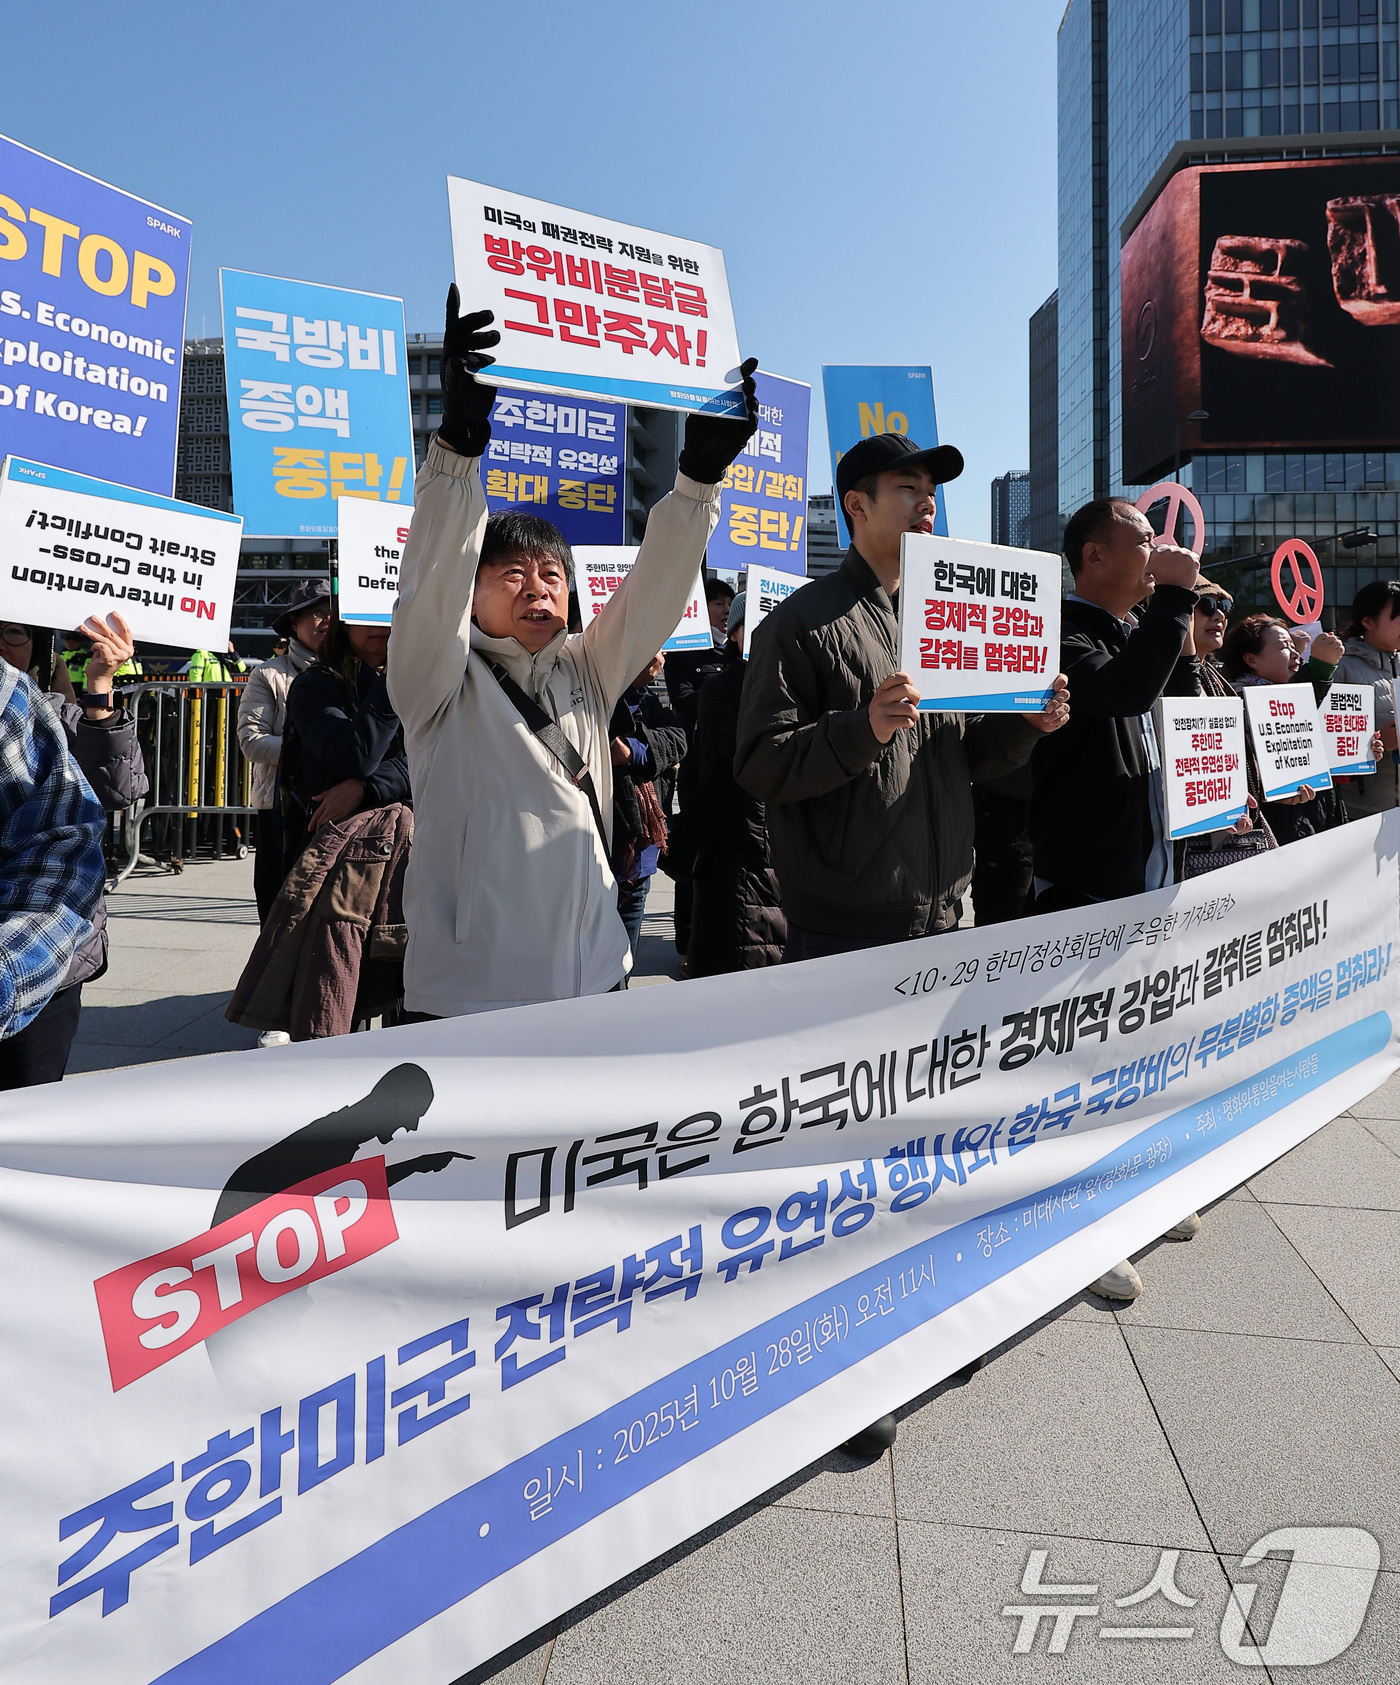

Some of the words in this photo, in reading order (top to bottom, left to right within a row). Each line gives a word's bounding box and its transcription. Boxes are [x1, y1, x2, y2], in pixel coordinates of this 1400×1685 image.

[146, 215, 181, 238] SPARK
[484, 205, 536, 233] 미국의
[542, 221, 613, 253] 패권전략
[618, 241, 664, 267] 지원을
[668, 254, 699, 276] 위한
[483, 233, 708, 319] 방위비분담금
[36, 301, 176, 366] Economic
[235, 306, 397, 376] 국방비
[504, 287, 708, 368] 그만주자!
[0, 336, 168, 402] ploitation
[907, 372, 927, 380] SPARK
[34, 393, 148, 437] Korea!
[239, 378, 350, 438] 증액
[493, 396, 616, 442] 주한미군
[758, 404, 784, 427] 대한
[858, 402, 909, 438] No
[18, 467, 47, 479] SPARK
[273, 446, 407, 501] 중단!
[488, 439, 552, 468] 전략적
[557, 448, 618, 476] 유연성
[486, 468, 548, 505] 확대
[557, 478, 616, 514] 중단
[25, 509, 143, 551] Conflict!
[729, 503, 804, 552] 중단!
[39, 544, 131, 575] Cross-
[149, 538, 216, 567] Strait
[374, 545, 400, 559] the
[384, 562, 398, 575] in
[586, 563, 615, 572] 주한미군
[11, 565, 175, 611] Intervention
[137, 562, 177, 585] the
[182, 571, 203, 590] in
[358, 575, 399, 591] Defe
[934, 560, 995, 597] 한국에
[1001, 570, 1037, 602] 대한
[180, 596, 216, 621] No
[924, 599, 986, 634] 경제적
[992, 606, 1043, 637] 강압과
[919, 638, 978, 670] 갈취를
[985, 643, 1048, 673] 멈춰라!
[1269, 700, 1295, 719] Stop
[1331, 693, 1362, 711] 불법적인
[1225, 717, 1237, 728] 없다!
[1258, 723, 1275, 736] U.S.
[1276, 720, 1313, 734] Economic
[1192, 733, 1222, 751] 주한미군
[1266, 737, 1313, 755] Exploitation
[1337, 736, 1359, 756] 중단!
[1175, 757, 1200, 777] 전략적
[1202, 755, 1223, 774] 유연성
[1224, 754, 1239, 770] 행사
[1275, 759, 1284, 769] of
[1286, 753, 1310, 768] Korea!
[1185, 777, 1231, 807] 중단하라!
[985, 924, 1126, 982] 한미정상회담에
[1126, 912, 1178, 946] 즈음한
[1178, 893, 1236, 930] 기자회견>
[505, 1111, 722, 1230] 미국은
[732, 1050, 897, 1154] 한국에
[906, 1025, 990, 1103] 대한
[999, 987, 1113, 1071] 경제적
[1118, 959, 1199, 1035] 강압과
[1203, 930, 1263, 1000] 갈취를
[1266, 900, 1328, 967] 멈춰라!
[1195, 1112, 1217, 1139] 주최
[1222, 1053, 1320, 1123] 평화와통일을여는사람들
[976, 1217, 1012, 1259] 장소
[1022, 1183, 1082, 1230] 미대사관
[1085, 1154, 1141, 1203] 앞(광화문
[1145, 1135, 1174, 1170] 광장)
[48, 1317, 476, 1619] 주한미군
[494, 1224, 703, 1392] 전략적
[717, 1156, 878, 1285] 유연성
[883, 1116, 1004, 1214] 행사와
[1007, 1082, 1081, 1158] 한국
[1085, 1036, 1196, 1116] 국방비의
[1194, 992, 1280, 1070] 무분별한
[1280, 968, 1334, 1027] 증액을
[1336, 942, 1393, 1001] 멈춰라!
[131, 1178, 368, 1351] STOP
[523, 1449, 583, 1522] 일시
[612, 1384, 699, 1466] 2025년
[708, 1352, 757, 1410] 10월
[765, 1303, 850, 1379] 28일(화)
[854, 1278, 896, 1327] 오전
[898, 1254, 937, 1300] 11시
